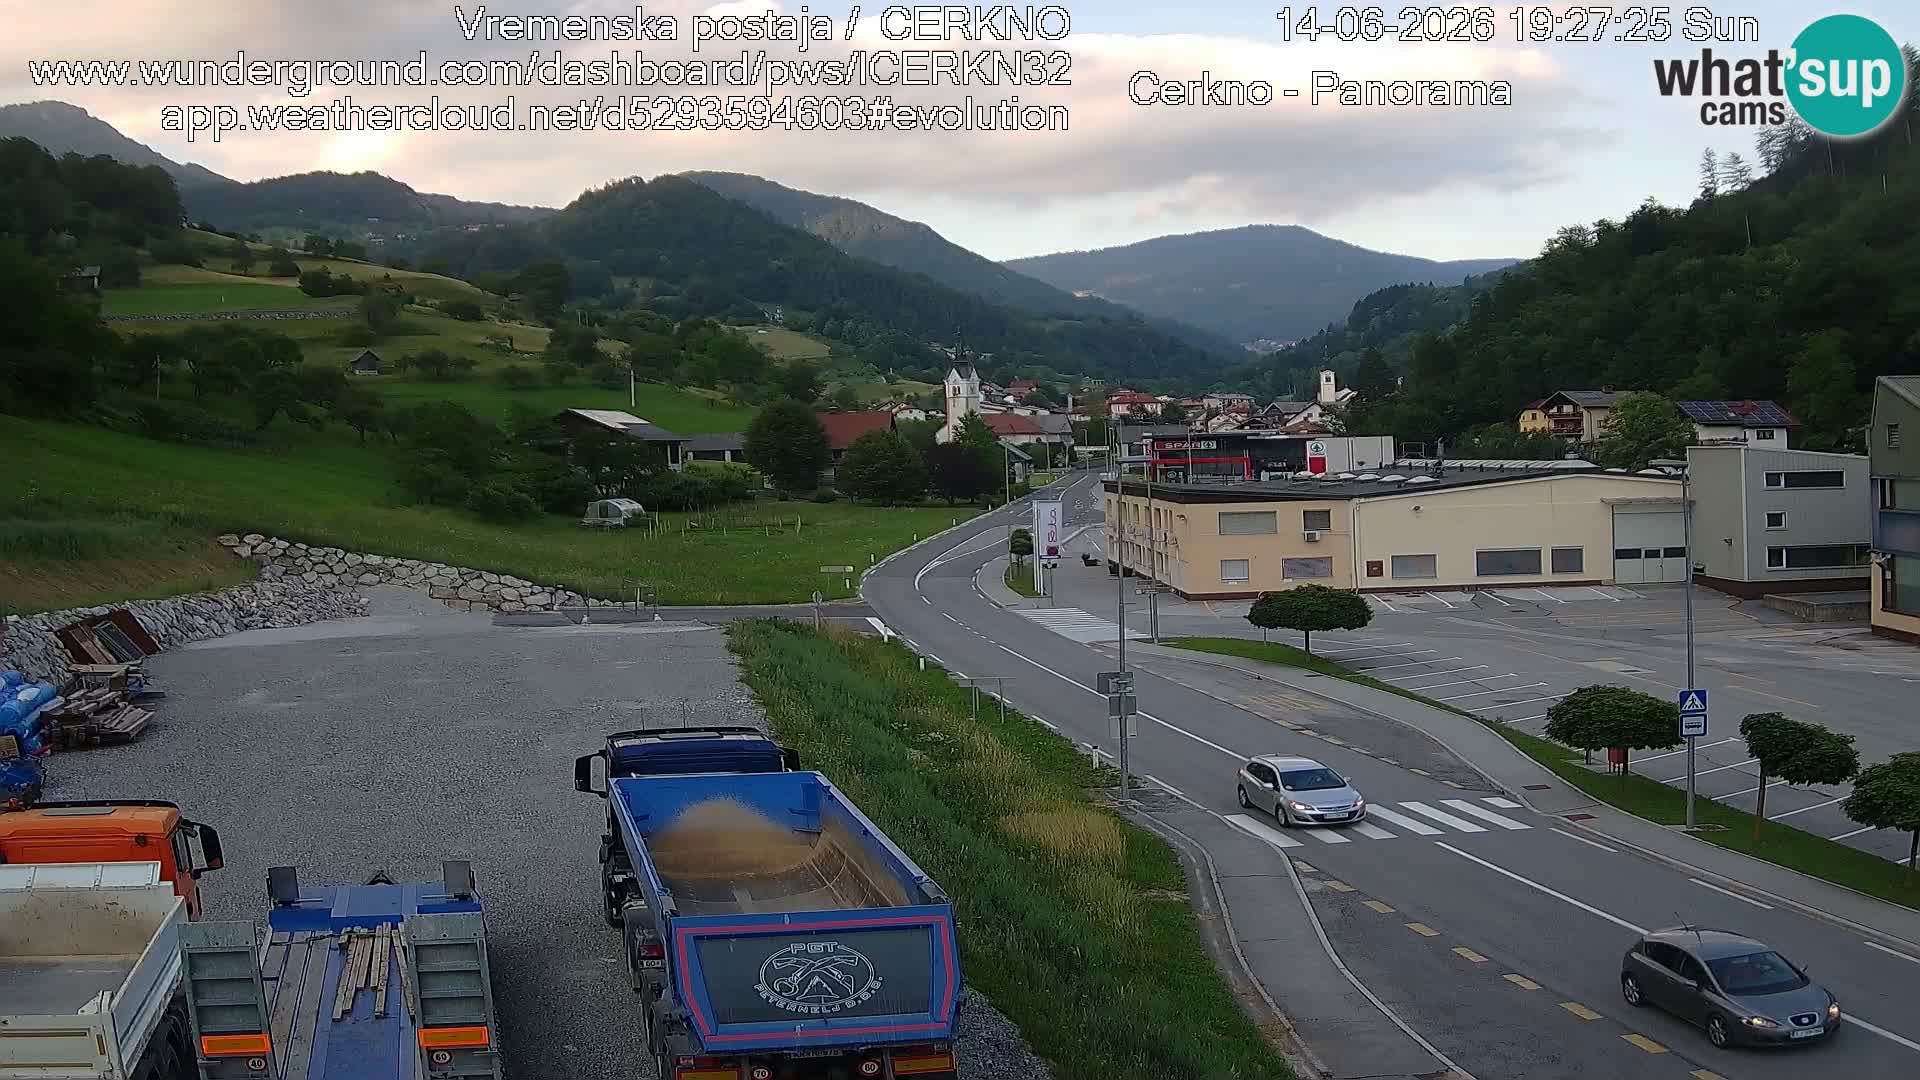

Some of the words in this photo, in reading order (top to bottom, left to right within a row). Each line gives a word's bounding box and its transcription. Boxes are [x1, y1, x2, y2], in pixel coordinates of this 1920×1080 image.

[791, 942, 838, 954] PGT
[754, 984, 841, 1014] PETERNELJ
[754, 1069, 768, 1078] 70
